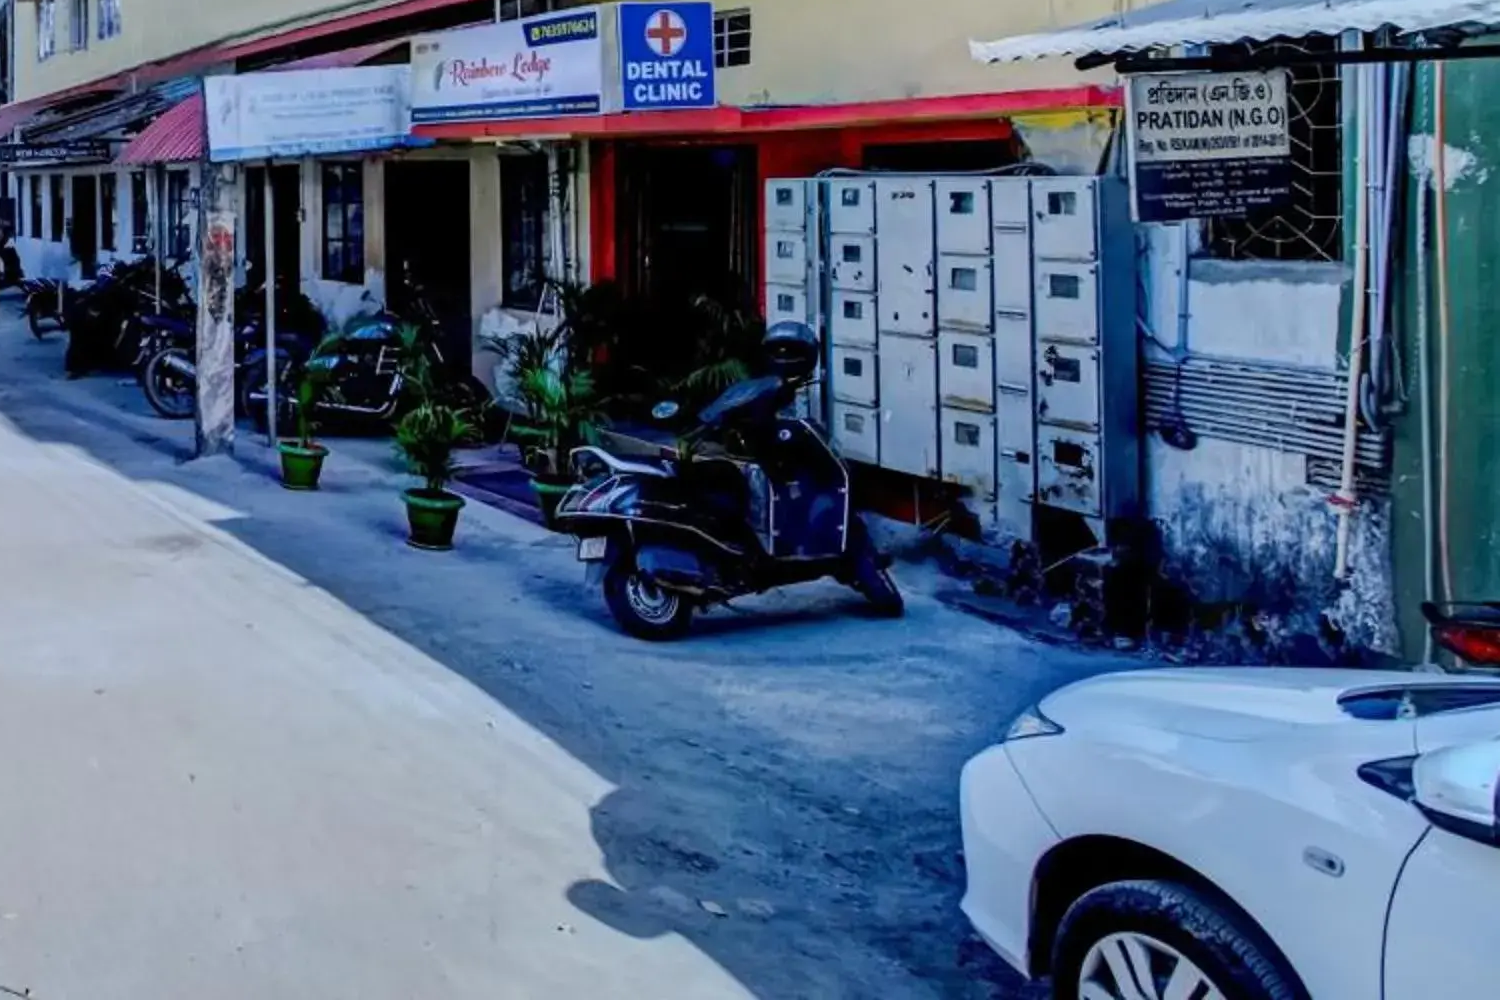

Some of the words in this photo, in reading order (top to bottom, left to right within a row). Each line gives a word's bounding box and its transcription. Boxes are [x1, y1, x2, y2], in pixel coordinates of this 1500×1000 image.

[627, 61, 708, 82] DENTAL
[633, 81, 703, 103] CLINIC
[1137, 109, 1223, 130] PRATIDAN
[1228, 106, 1286, 130] (N.G.O)
